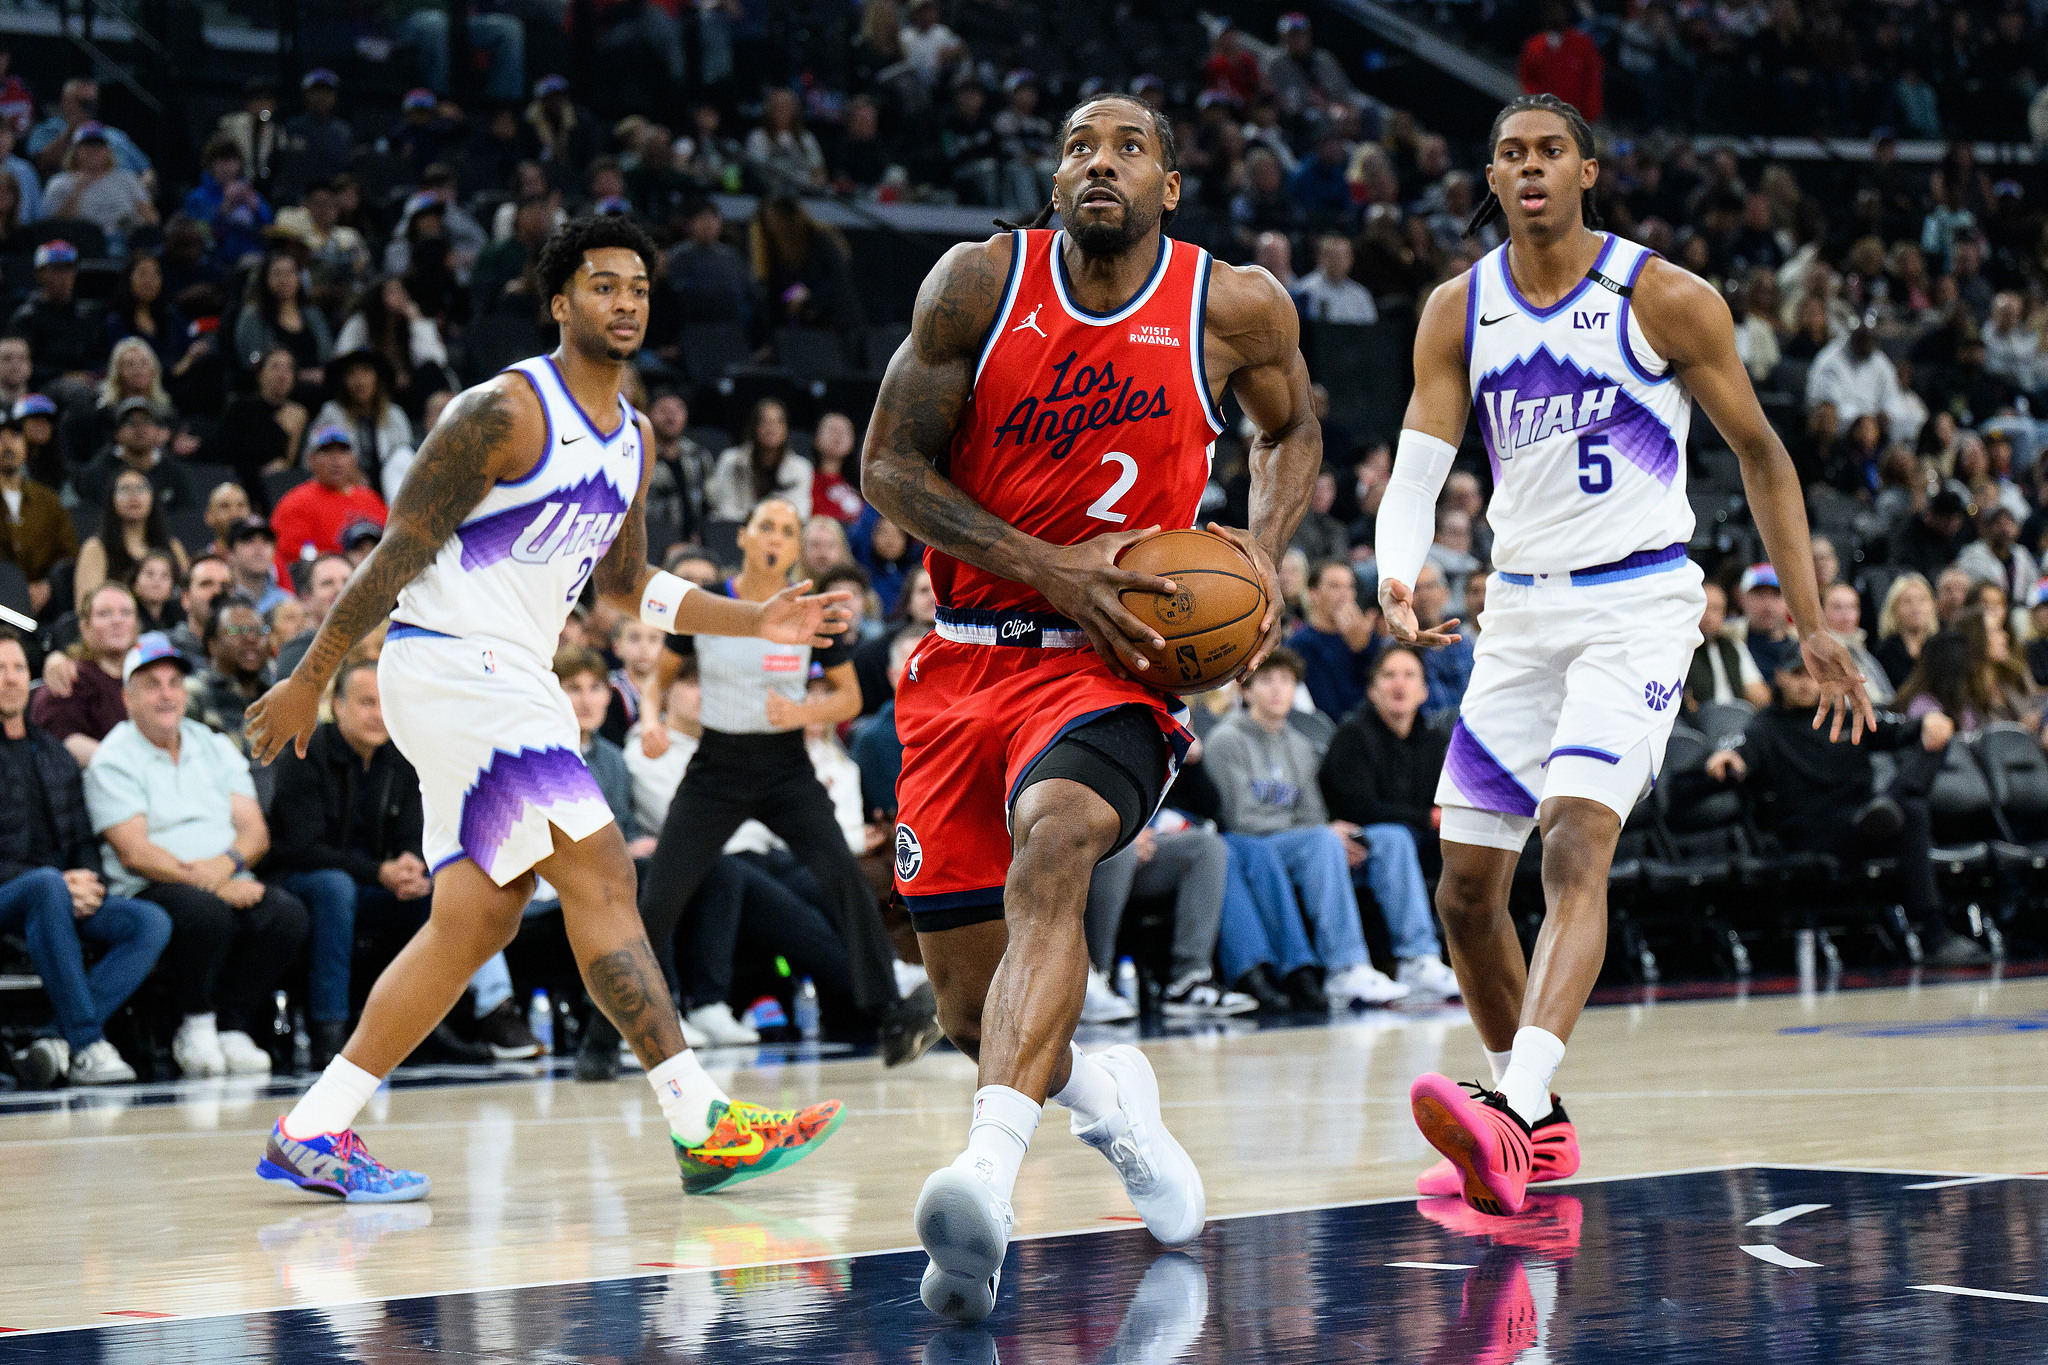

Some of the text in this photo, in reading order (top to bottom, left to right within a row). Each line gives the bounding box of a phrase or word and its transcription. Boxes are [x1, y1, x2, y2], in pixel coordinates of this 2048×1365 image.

[1129, 333, 1180, 347] RWANDA
[1140, 325, 1171, 336] VISIT
[1573, 311, 1611, 330] LVT
[1043, 350, 1121, 404] Los
[992, 376, 1173, 460] Angeles
[1482, 383, 1624, 461] UTAH
[1085, 451, 1139, 524] 2
[1577, 434, 1613, 495] 5
[566, 556, 601, 602] 2
[1001, 618, 1036, 640] Clips
